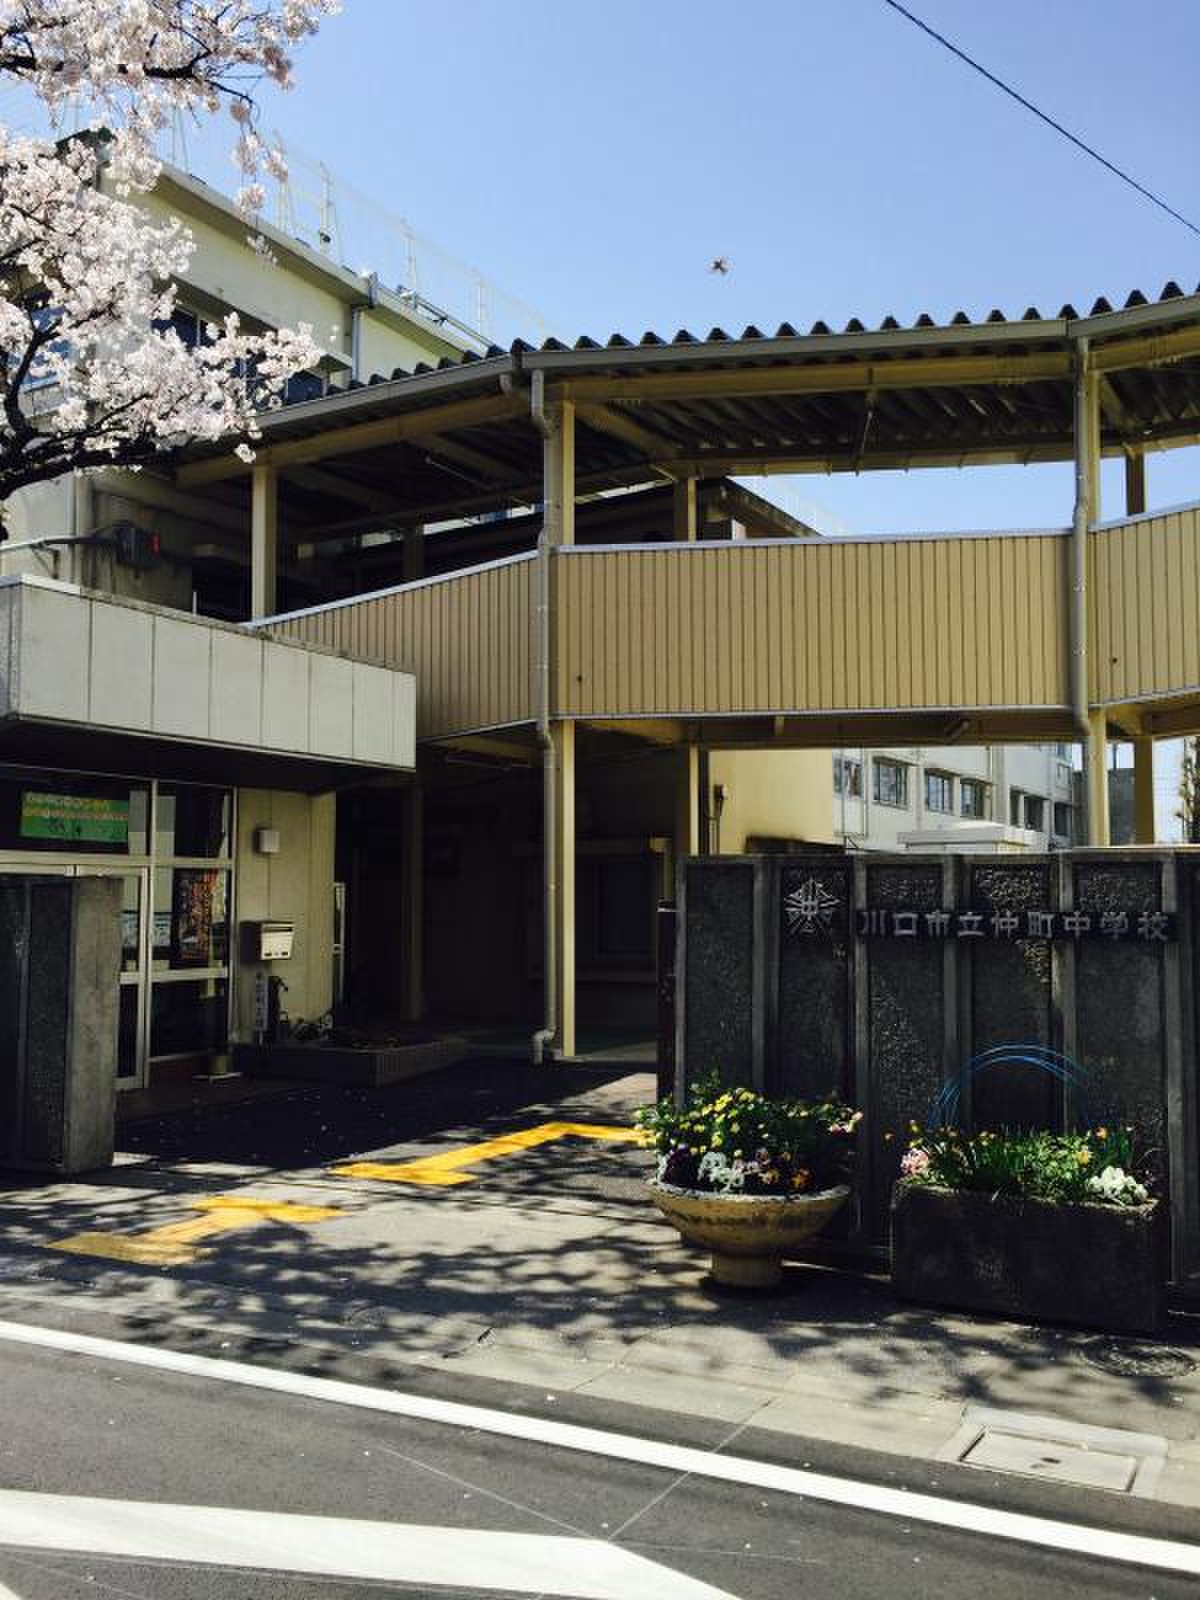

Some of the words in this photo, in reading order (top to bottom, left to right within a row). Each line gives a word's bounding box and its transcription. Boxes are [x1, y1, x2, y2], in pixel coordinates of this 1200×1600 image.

[860, 911, 1169, 941] 川口市立仲町中学校
